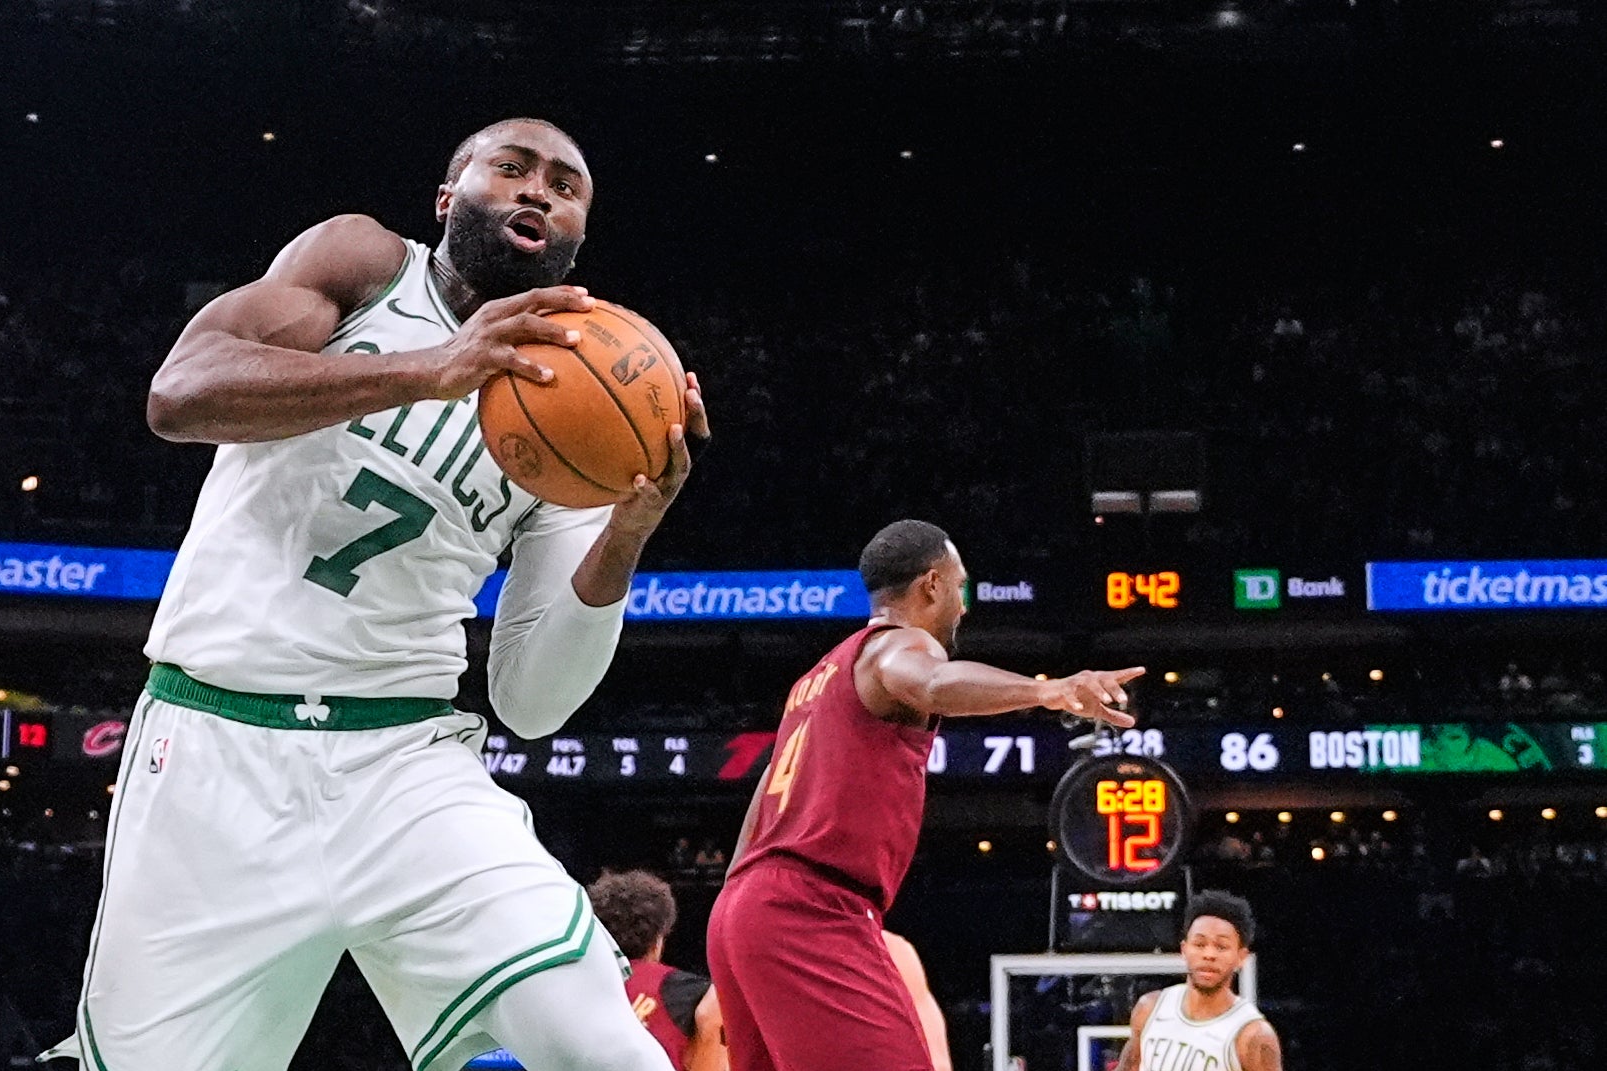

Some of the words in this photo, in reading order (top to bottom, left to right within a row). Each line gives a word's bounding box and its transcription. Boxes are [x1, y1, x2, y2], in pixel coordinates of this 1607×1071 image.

[303, 466, 438, 598] 7
[976, 581, 1034, 602] Bank
[1106, 571, 1181, 609] 8:42
[1242, 575, 1277, 602] TD
[1287, 576, 1345, 598] Bank
[619, 754, 637, 777] 5
[668, 753, 686, 776] 4
[767, 716, 812, 815] 4
[982, 735, 1036, 775] 71
[1220, 733, 1279, 772] 86
[1308, 730, 1421, 769] BOSTON
[1096, 779, 1166, 814] 6:28
[1108, 813, 1161, 872] 12
[1096, 891, 1178, 911] TISSOT
